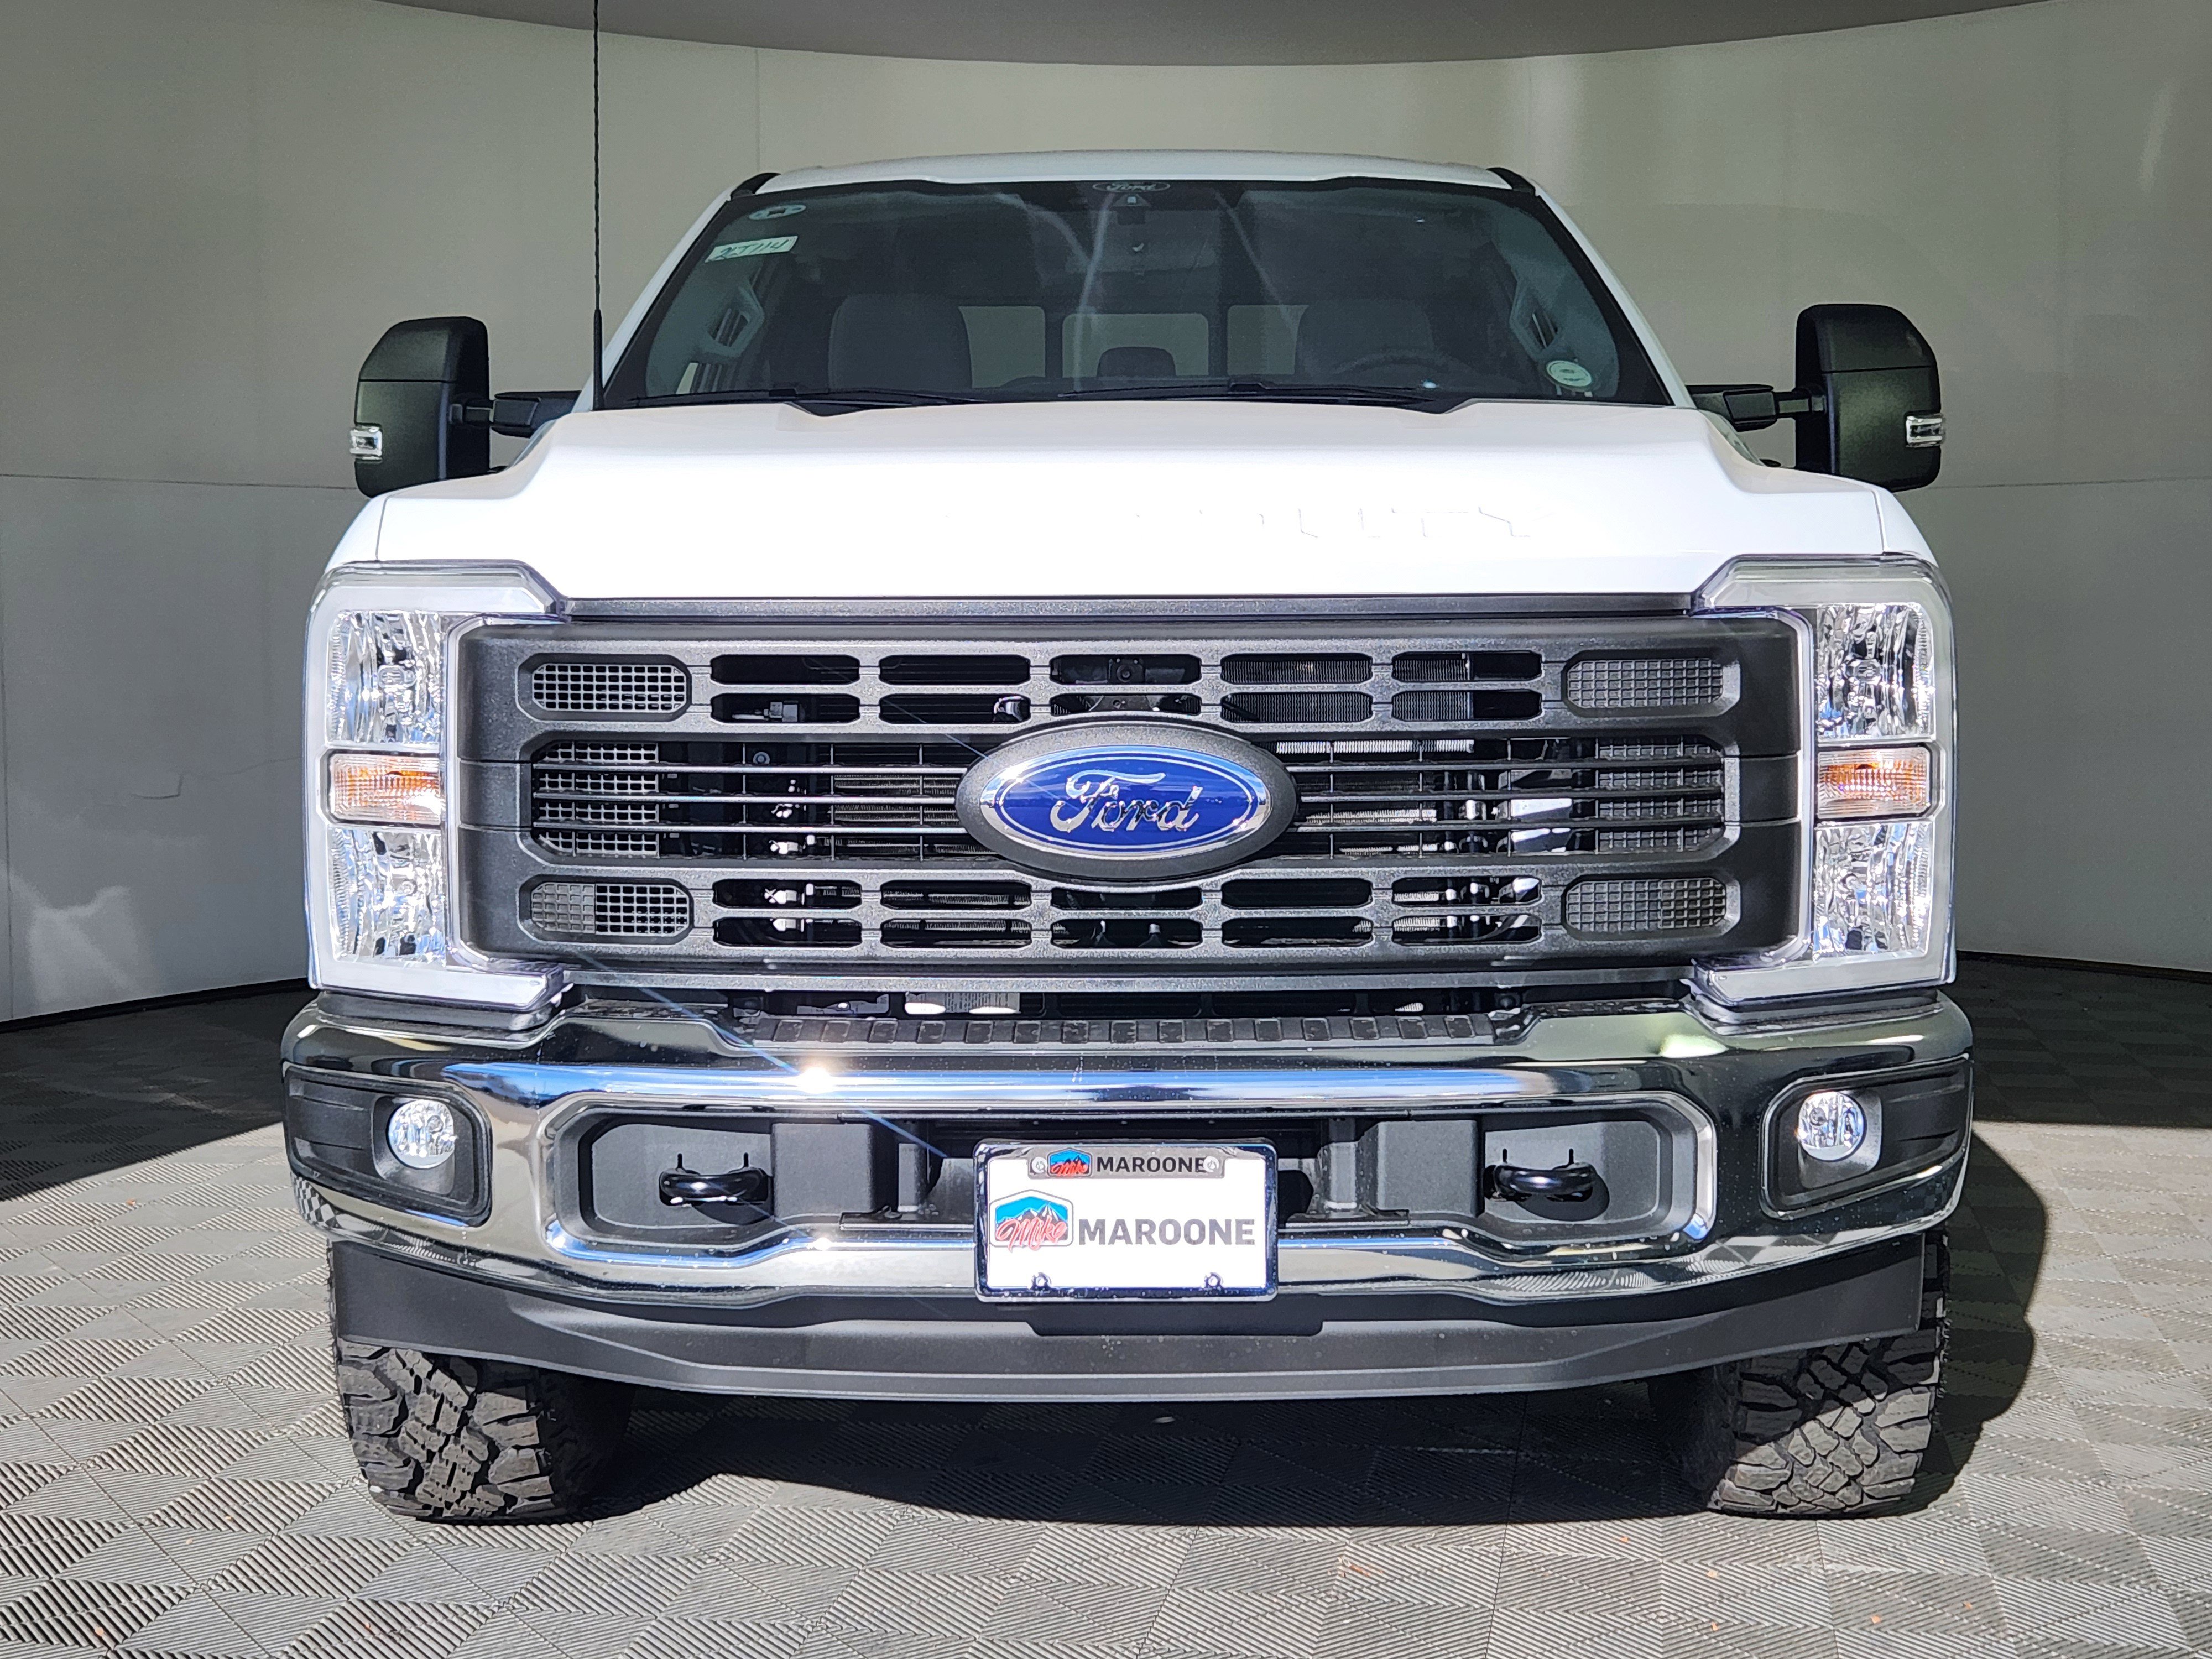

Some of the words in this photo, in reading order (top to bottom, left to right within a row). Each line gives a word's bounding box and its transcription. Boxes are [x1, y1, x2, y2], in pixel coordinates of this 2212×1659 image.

[1050, 769, 1204, 831] Ford
[1097, 1156, 1207, 1173] MAROONE
[996, 1215, 1068, 1253] Mike
[1078, 1218, 1255, 1245] MAROONE
